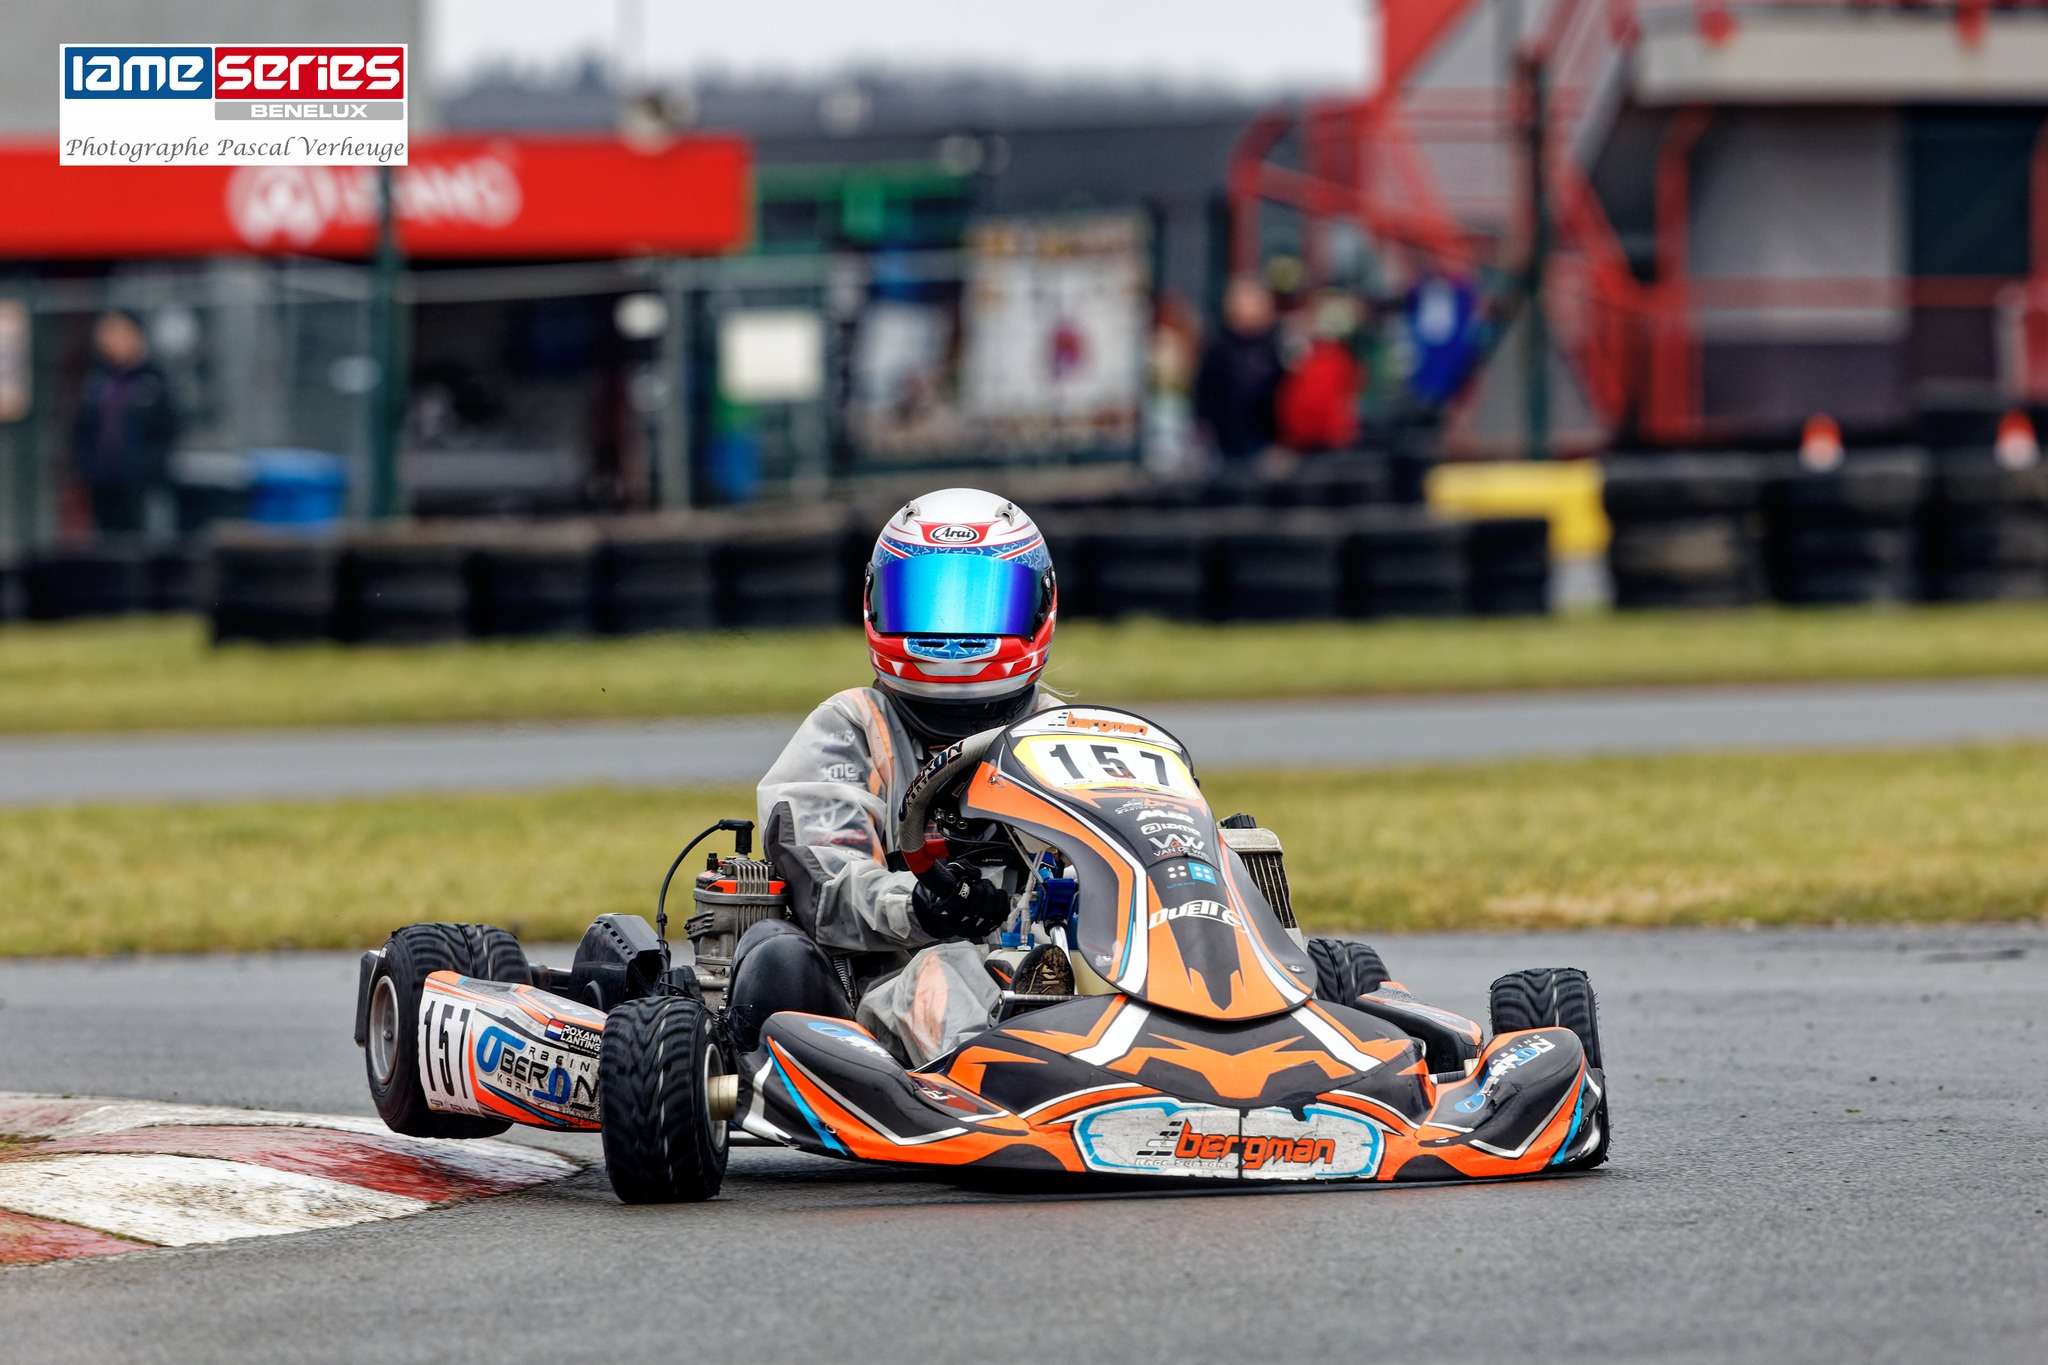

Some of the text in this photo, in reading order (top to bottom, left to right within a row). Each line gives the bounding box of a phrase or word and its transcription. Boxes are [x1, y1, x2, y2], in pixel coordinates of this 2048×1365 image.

[942, 525, 973, 539] Arai
[1049, 744, 1169, 787] 157
[424, 1000, 472, 1100] 157
[560, 1032, 601, 1051] LANTING
[563, 1024, 602, 1043] ROXANN
[476, 1025, 600, 1105] OBERON
[1174, 1117, 1336, 1170] bergman
